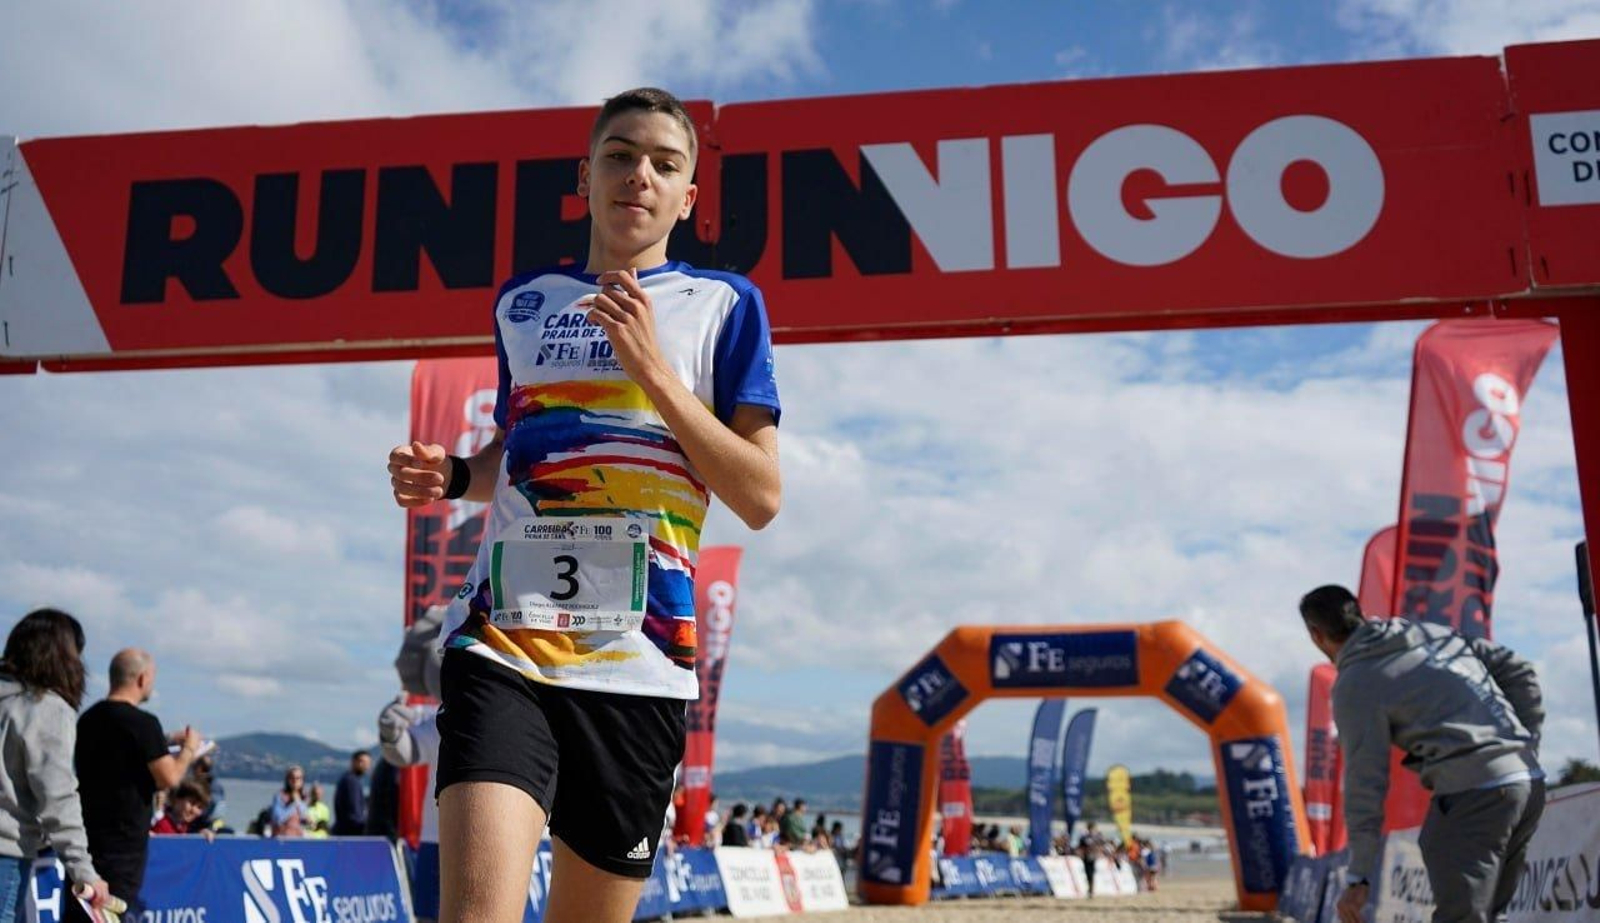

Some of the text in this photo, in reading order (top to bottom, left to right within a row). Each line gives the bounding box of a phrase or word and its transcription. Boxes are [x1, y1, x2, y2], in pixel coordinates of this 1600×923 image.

[1573, 160, 1600, 183] D
[541, 329, 579, 340] PRAIA
[582, 328, 598, 338] DE
[589, 340, 618, 359] 10
[524, 524, 567, 535] CARREIRA
[594, 525, 612, 535] 100
[550, 555, 580, 601] 3
[627, 851, 650, 859] adidas
[333, 892, 396, 922] seguros
